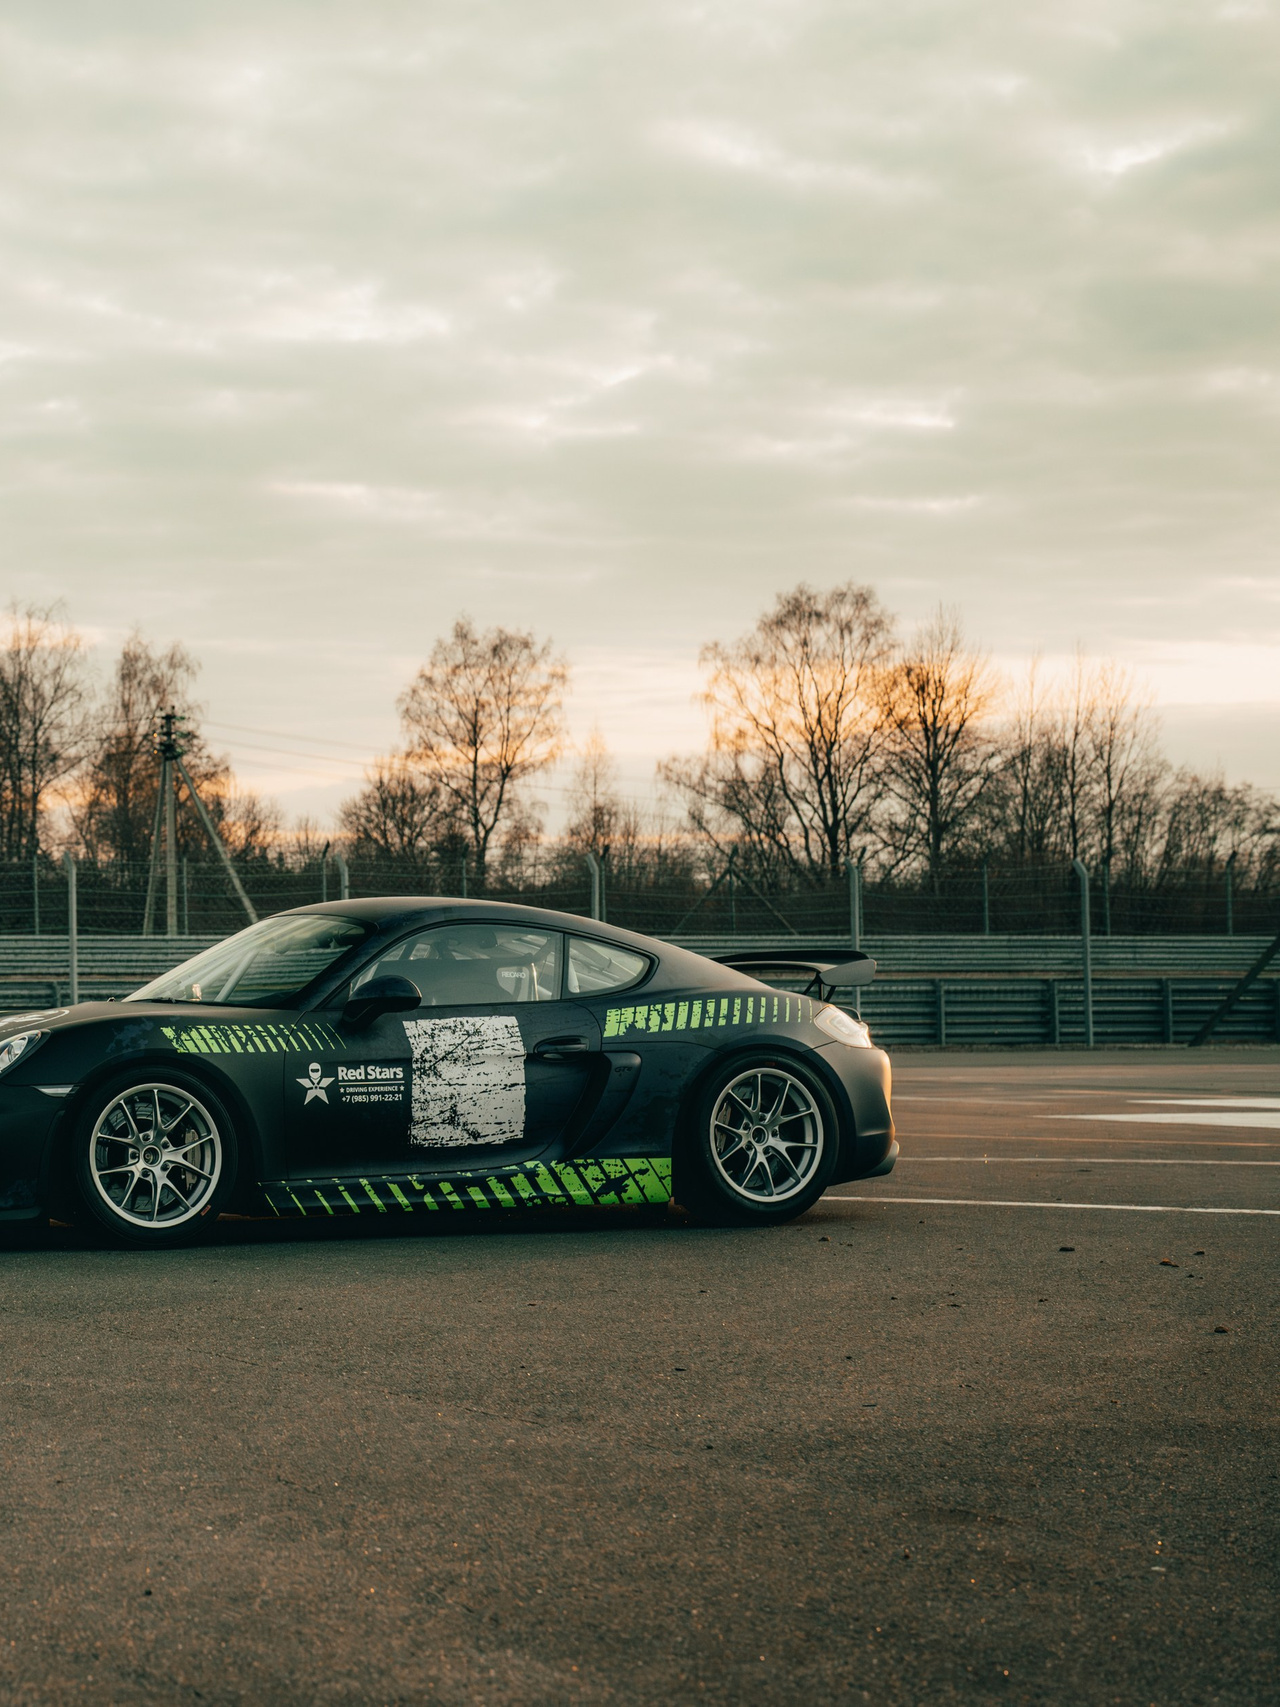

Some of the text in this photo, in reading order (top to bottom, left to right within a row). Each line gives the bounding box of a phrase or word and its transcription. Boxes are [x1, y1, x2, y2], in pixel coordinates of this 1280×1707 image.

[501, 971, 526, 979] RECARO
[337, 1065, 403, 1080] Red Stars
[351, 1095, 369, 1103] (985)
[370, 1094, 402, 1102] 991-22-21
